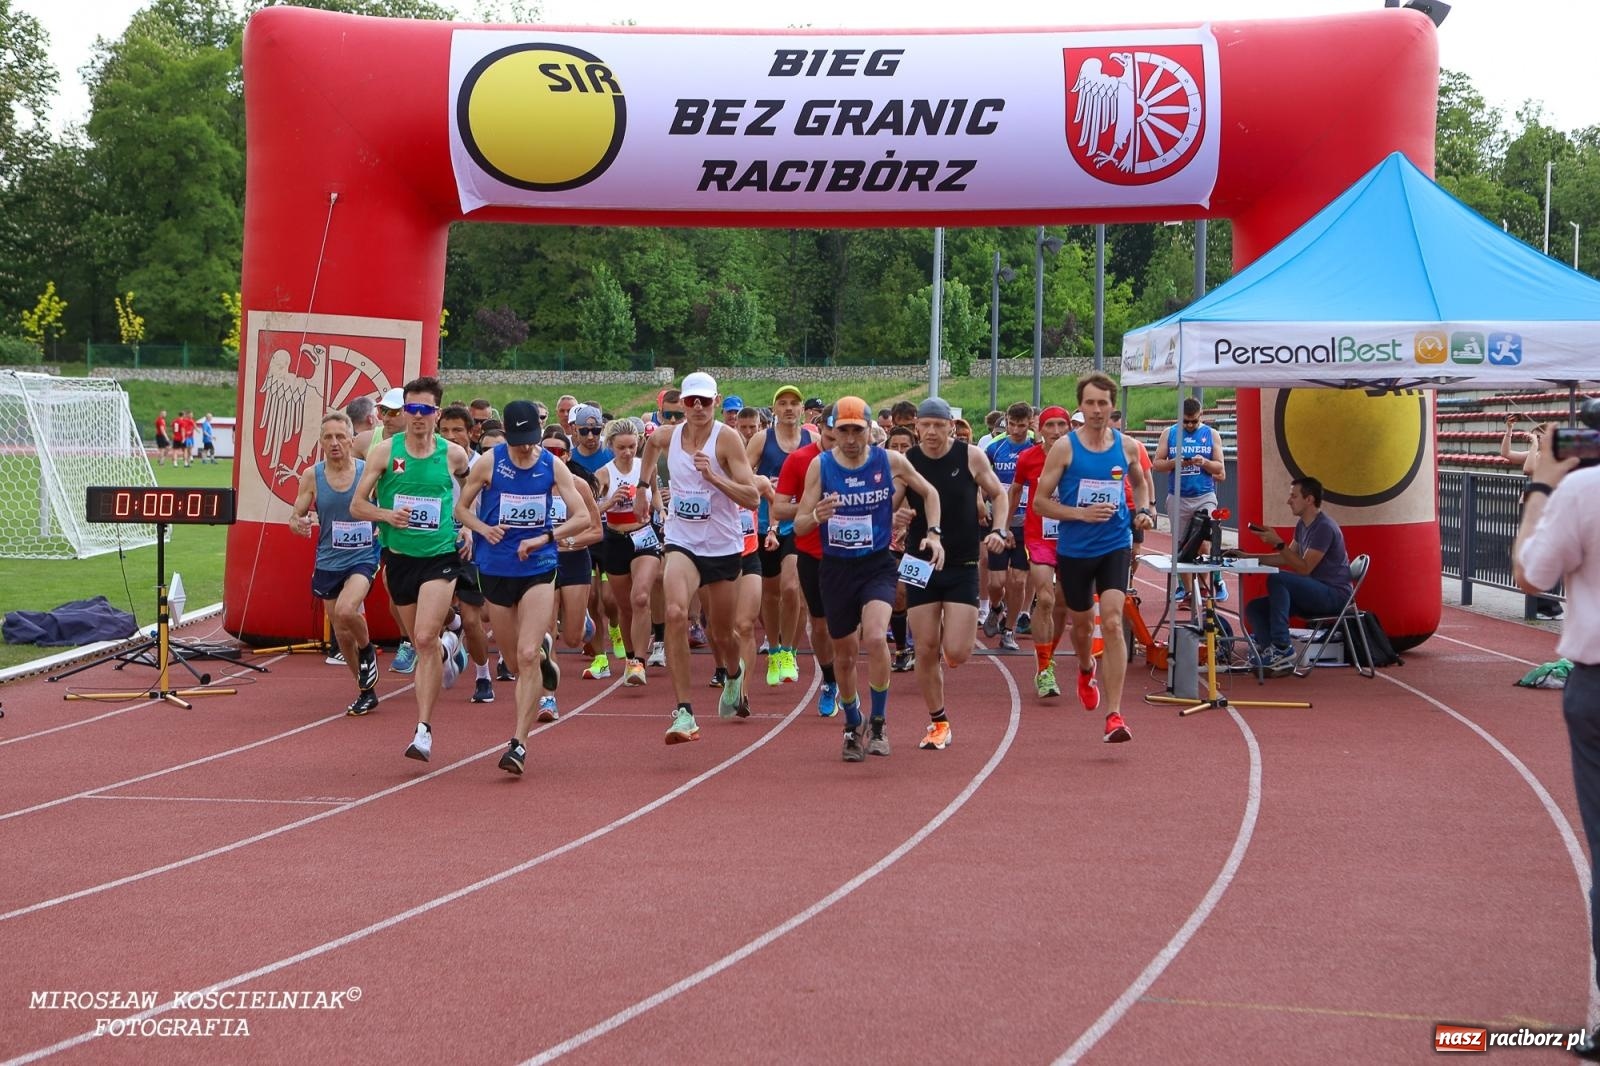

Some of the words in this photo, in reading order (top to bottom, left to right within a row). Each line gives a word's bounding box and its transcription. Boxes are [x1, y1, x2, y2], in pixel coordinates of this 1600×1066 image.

[768, 48, 905, 77] BIEG
[668, 98, 786, 136] BEZ
[793, 98, 1006, 136] GRANIC
[696, 150, 978, 192] RACIBÓRZ
[823, 487, 890, 507] RNNERS
[1090, 492, 1111, 504] 251
[115, 493, 218, 517] 0:00:01
[679, 500, 700, 514] 220
[410, 509, 428, 521] 58
[510, 508, 536, 520] 249
[343, 532, 363, 543] 241
[838, 529, 860, 540] 163
[903, 564, 920, 577] 193
